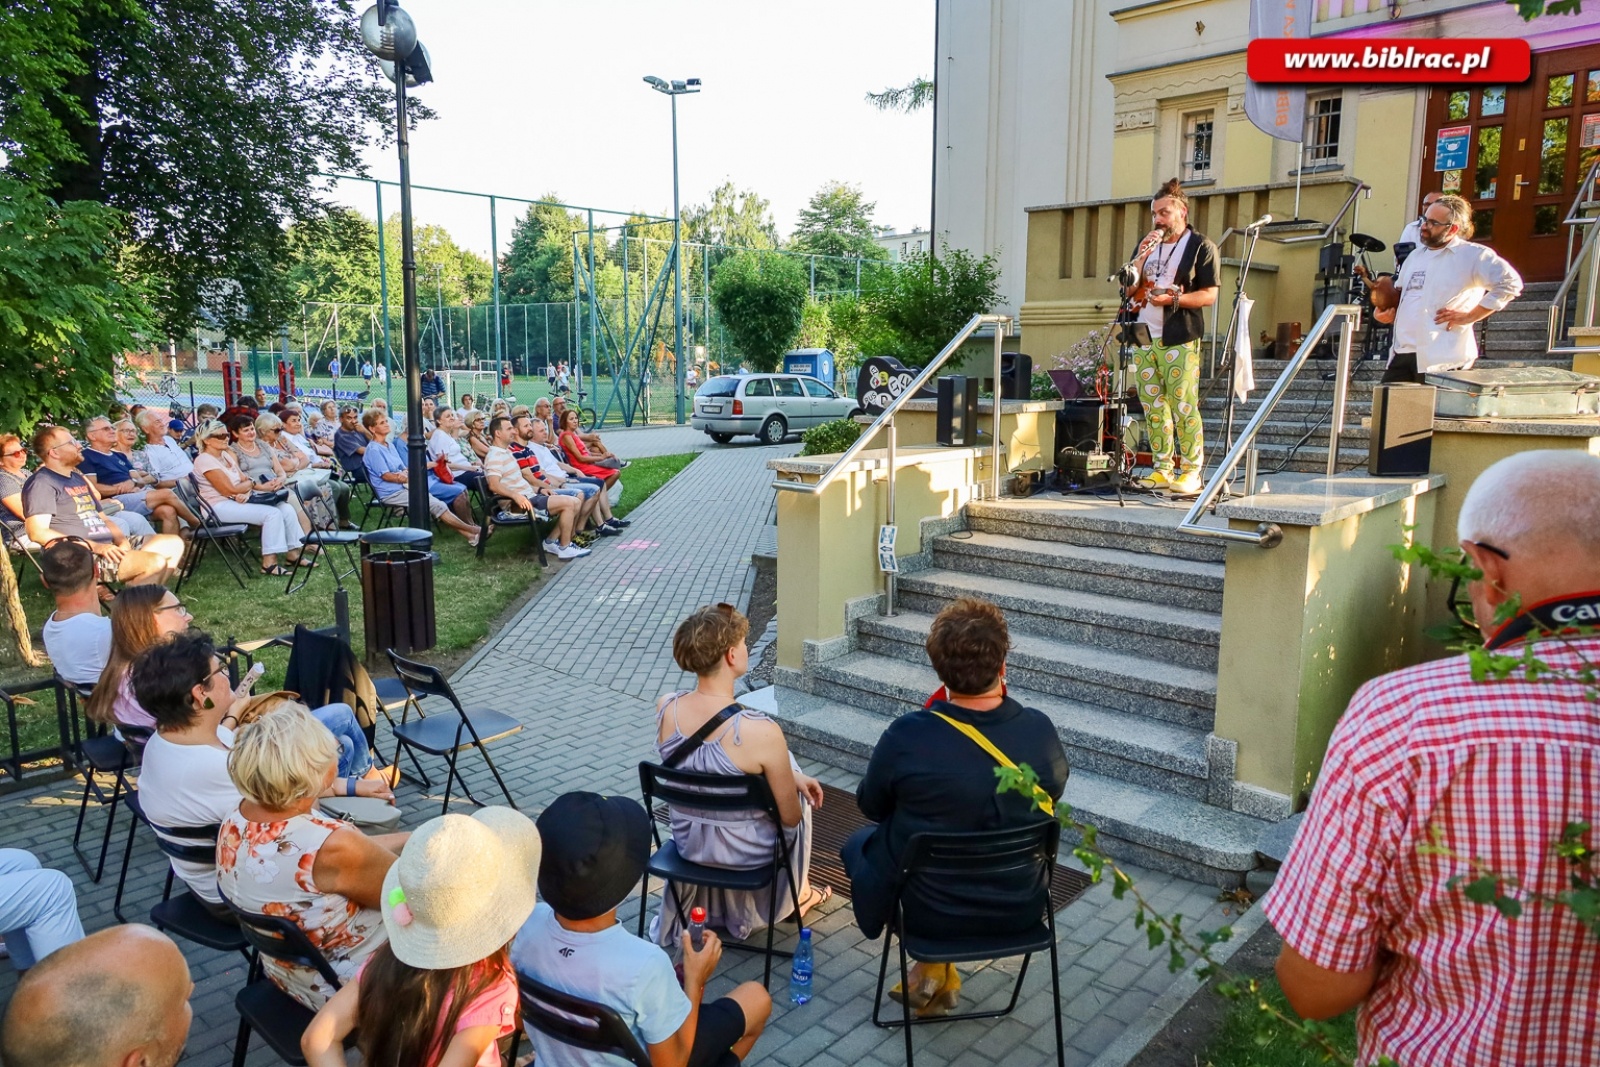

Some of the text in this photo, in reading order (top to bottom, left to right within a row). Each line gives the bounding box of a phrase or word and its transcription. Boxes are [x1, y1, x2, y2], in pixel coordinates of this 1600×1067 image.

[890, 380, 900, 392] LT
[864, 392, 877, 403] RUS
[880, 395, 889, 405] D
